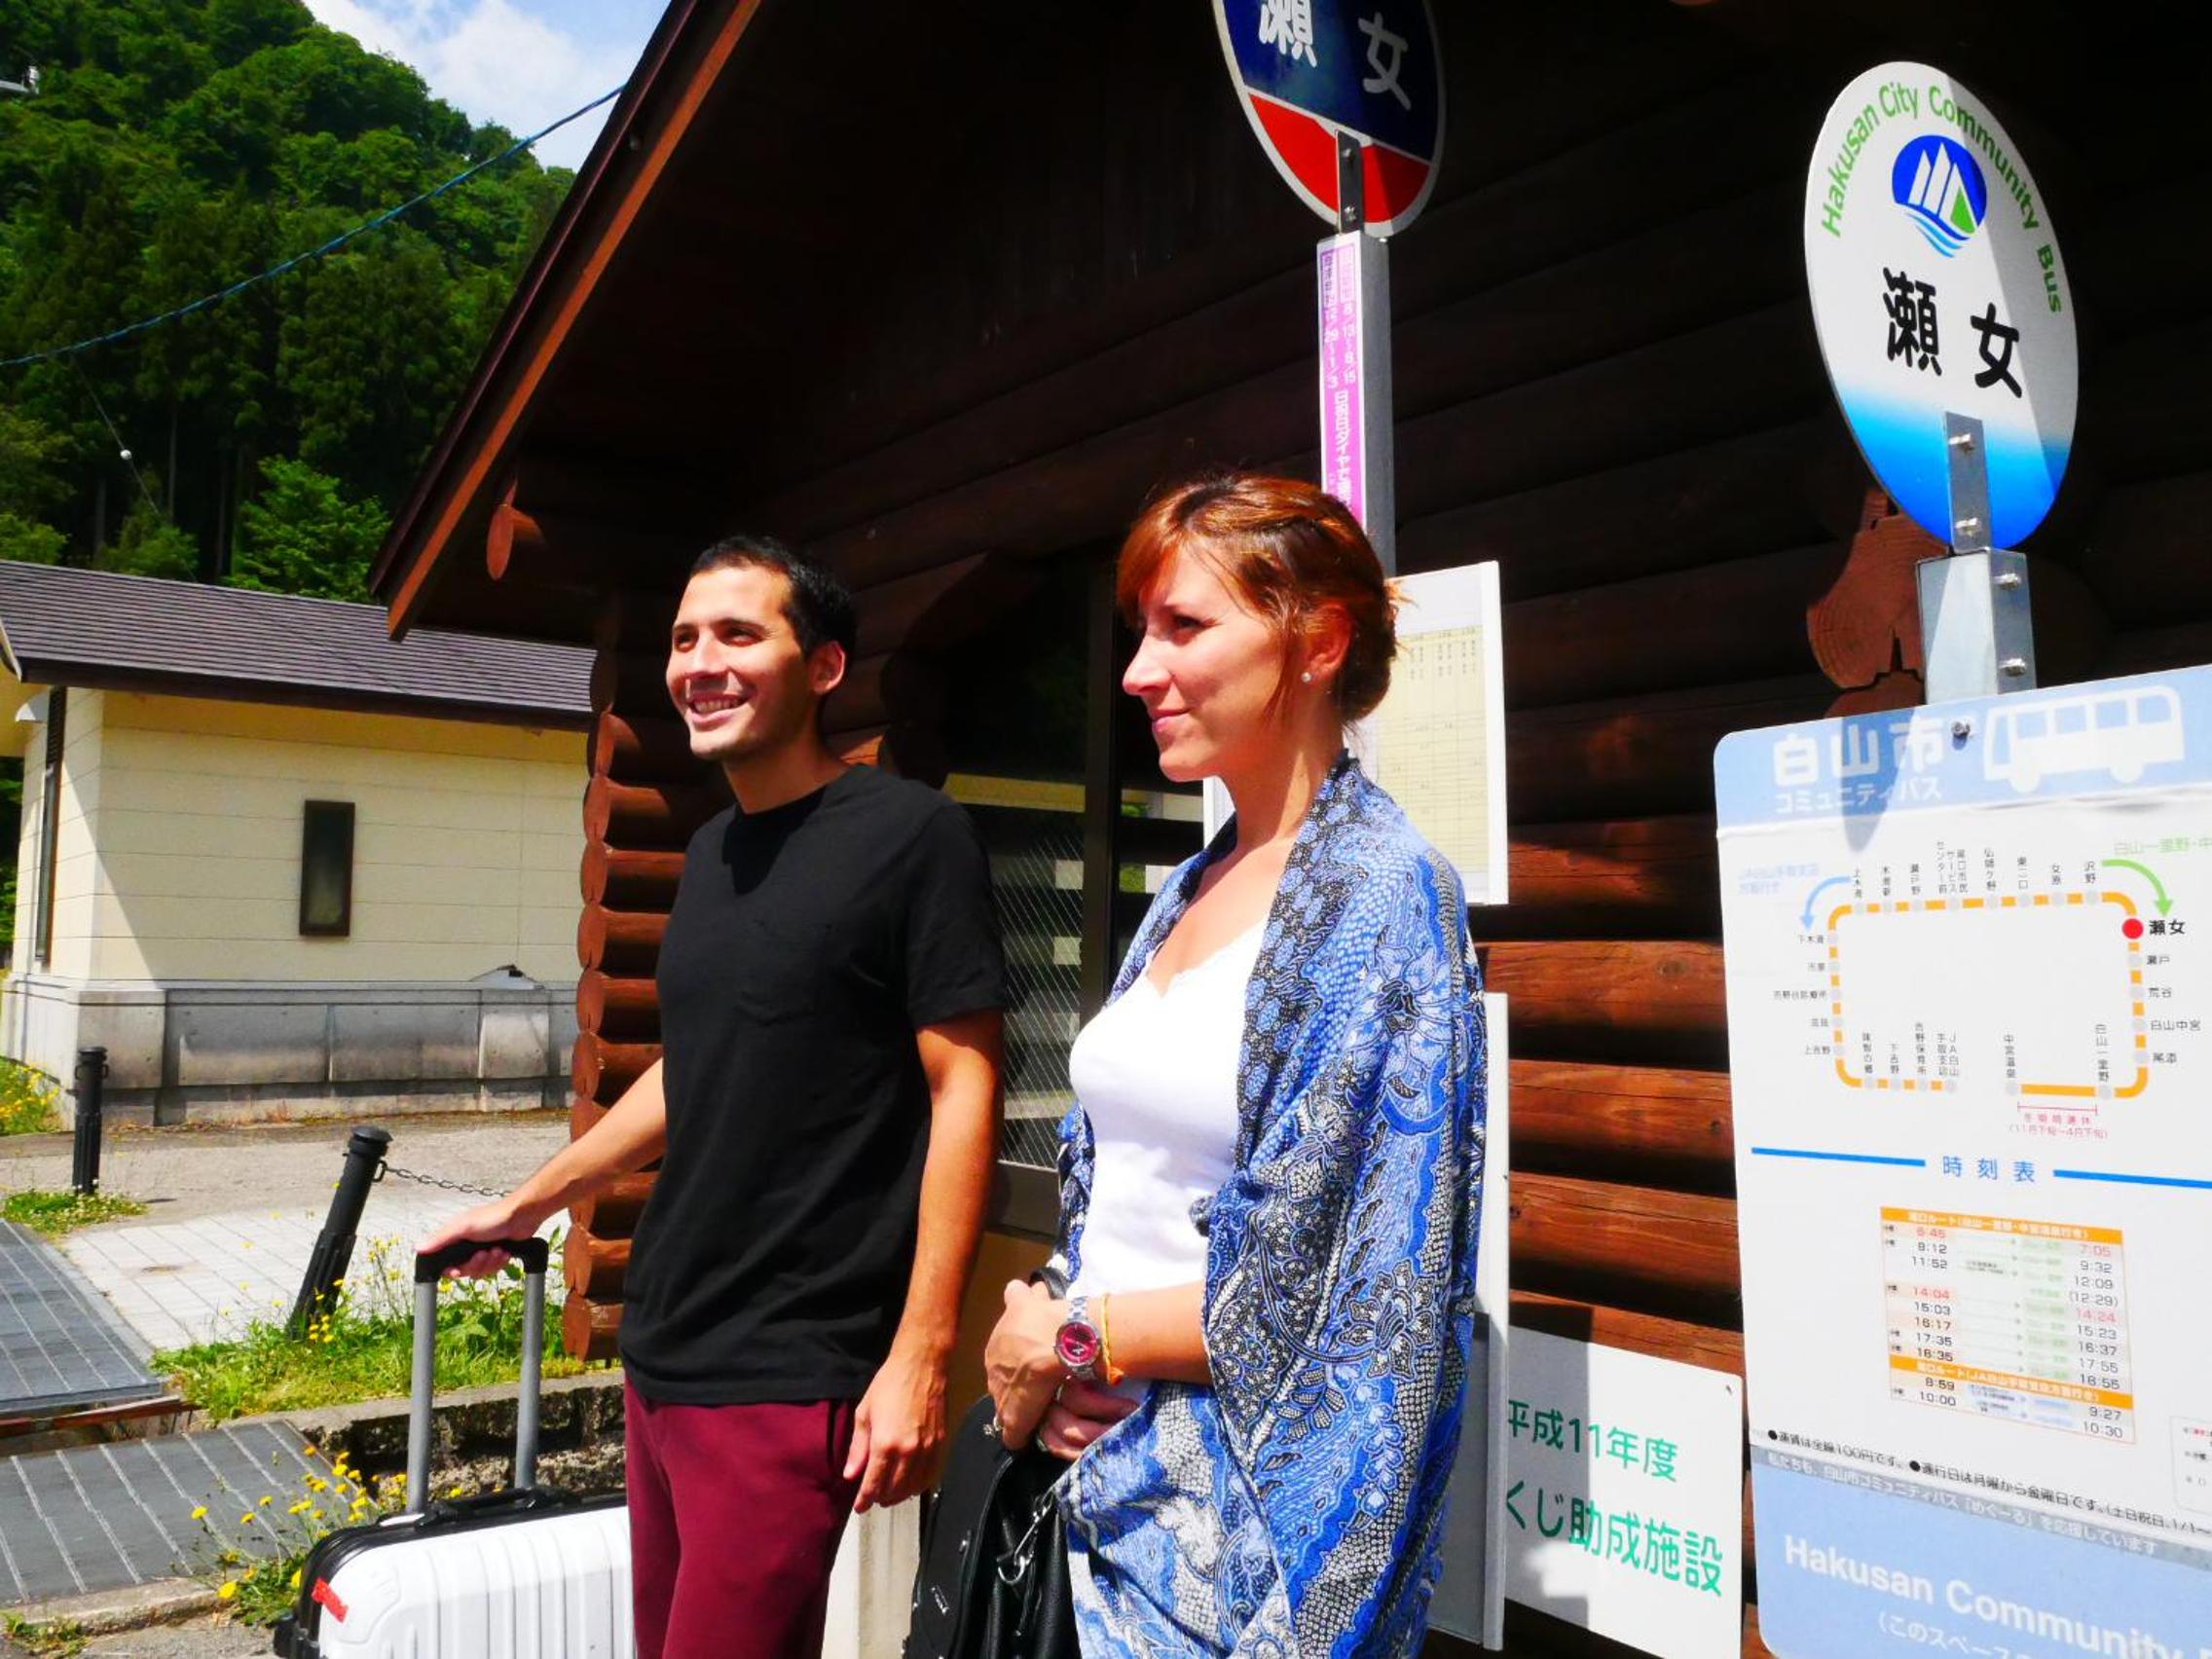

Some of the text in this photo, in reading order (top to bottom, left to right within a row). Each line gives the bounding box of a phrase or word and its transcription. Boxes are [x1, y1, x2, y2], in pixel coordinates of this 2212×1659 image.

[1822, 82, 2062, 314] Hakusan City Community Bus
[1883, 267, 2022, 398] 瀬女
[1773, 719, 1943, 787] 白山市
[1775, 776, 1943, 814] コミュニティバス
[2149, 918, 2186, 936] 瀬女
[1942, 1155, 2037, 1184] 時刻表
[1912, 1255, 1948, 1270] 11:52
[1915, 1302, 1951, 1316] 15:03
[1917, 1332, 1953, 1346] 17:35
[1919, 1391, 1957, 1407] 10:00
[1508, 1399, 1677, 1483] 平成11年度
[1506, 1480, 1723, 1598] くじ助成施設
[1784, 1534, 2184, 1659] Hakusan Communit
